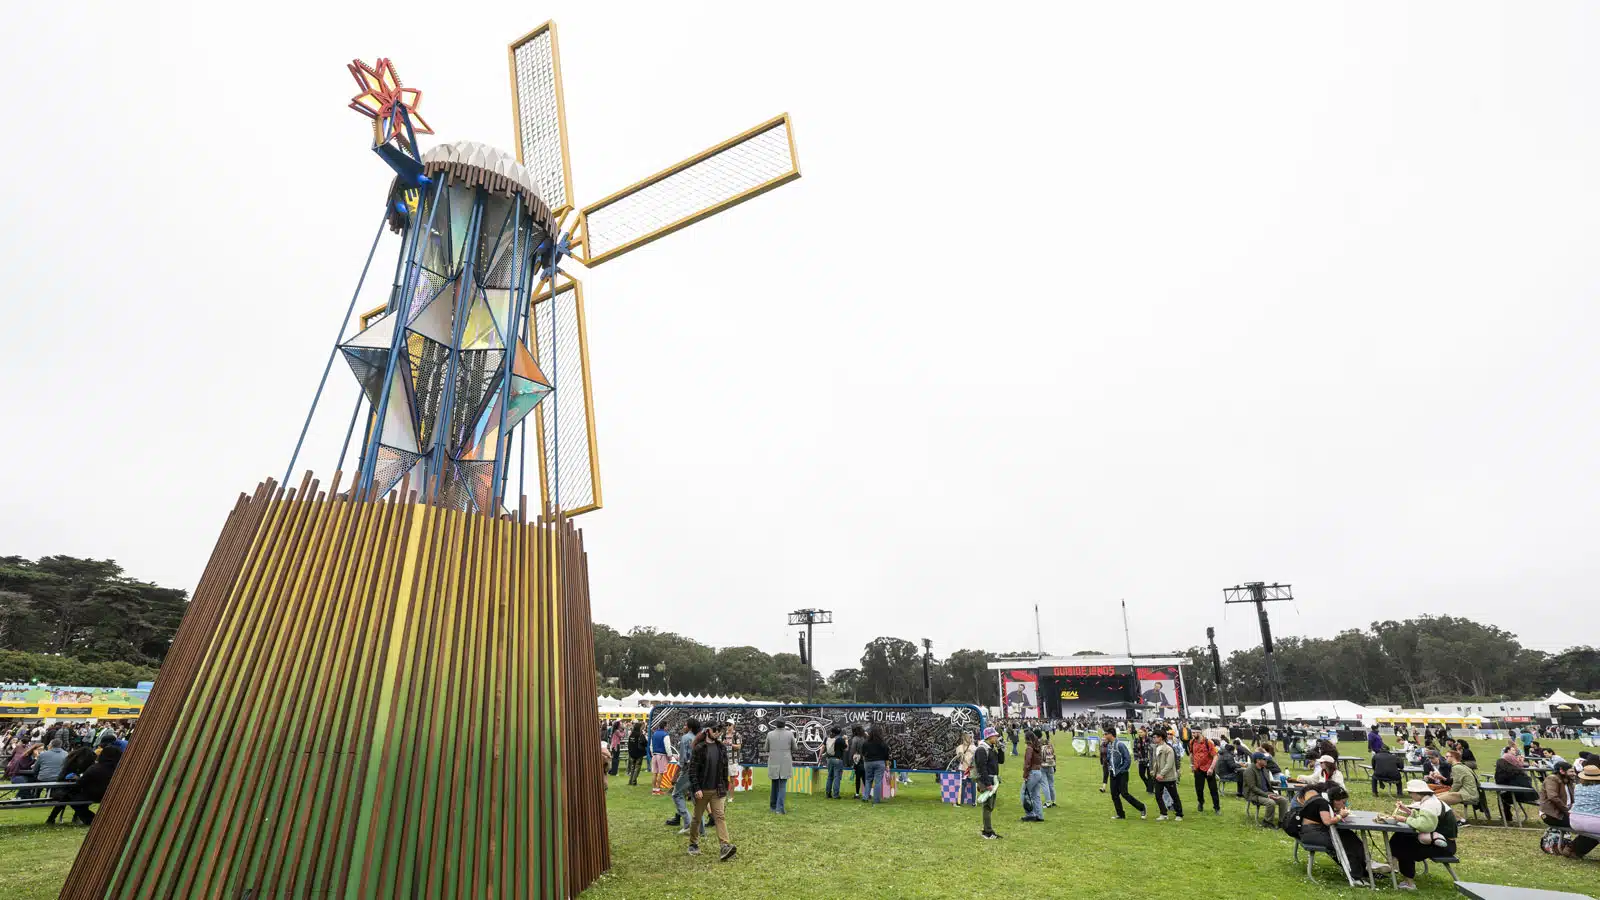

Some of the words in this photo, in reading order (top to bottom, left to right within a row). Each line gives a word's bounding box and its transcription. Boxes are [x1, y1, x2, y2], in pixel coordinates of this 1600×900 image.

[715, 711, 726, 722] TO
[729, 713, 742, 723] SEE
[849, 711, 870, 722] CAME
[872, 710, 883, 721] TO
[885, 711, 906, 723] HEAR
